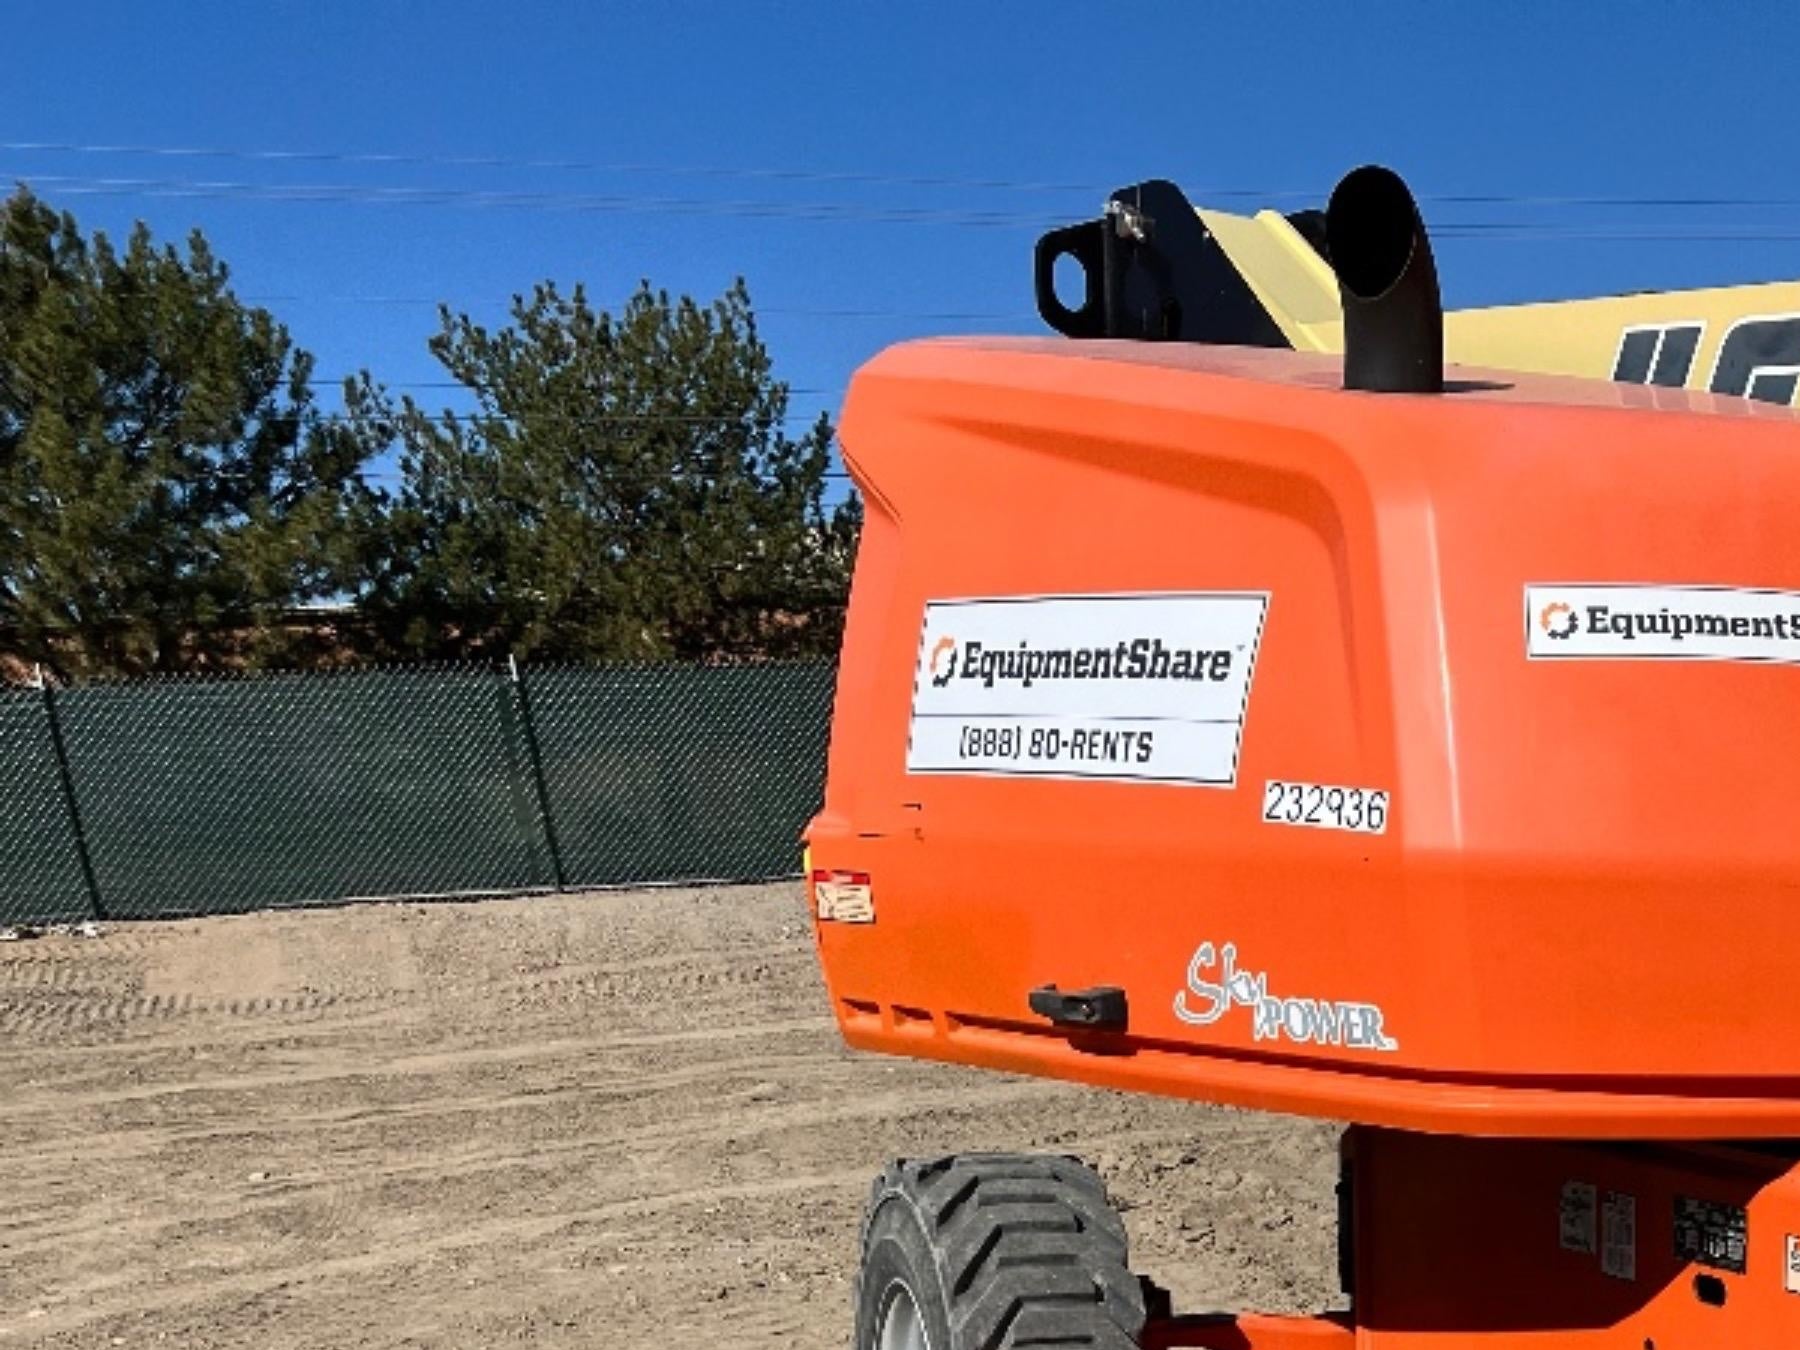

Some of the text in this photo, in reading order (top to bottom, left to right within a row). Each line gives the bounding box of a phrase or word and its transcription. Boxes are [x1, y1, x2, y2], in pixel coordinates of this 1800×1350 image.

[959, 641, 1231, 688] EquipmentShare
[958, 725, 1154, 763] (888) 80-RENTS
[1265, 783, 1386, 830] 232936
[1254, 995, 1398, 1051] POWER
